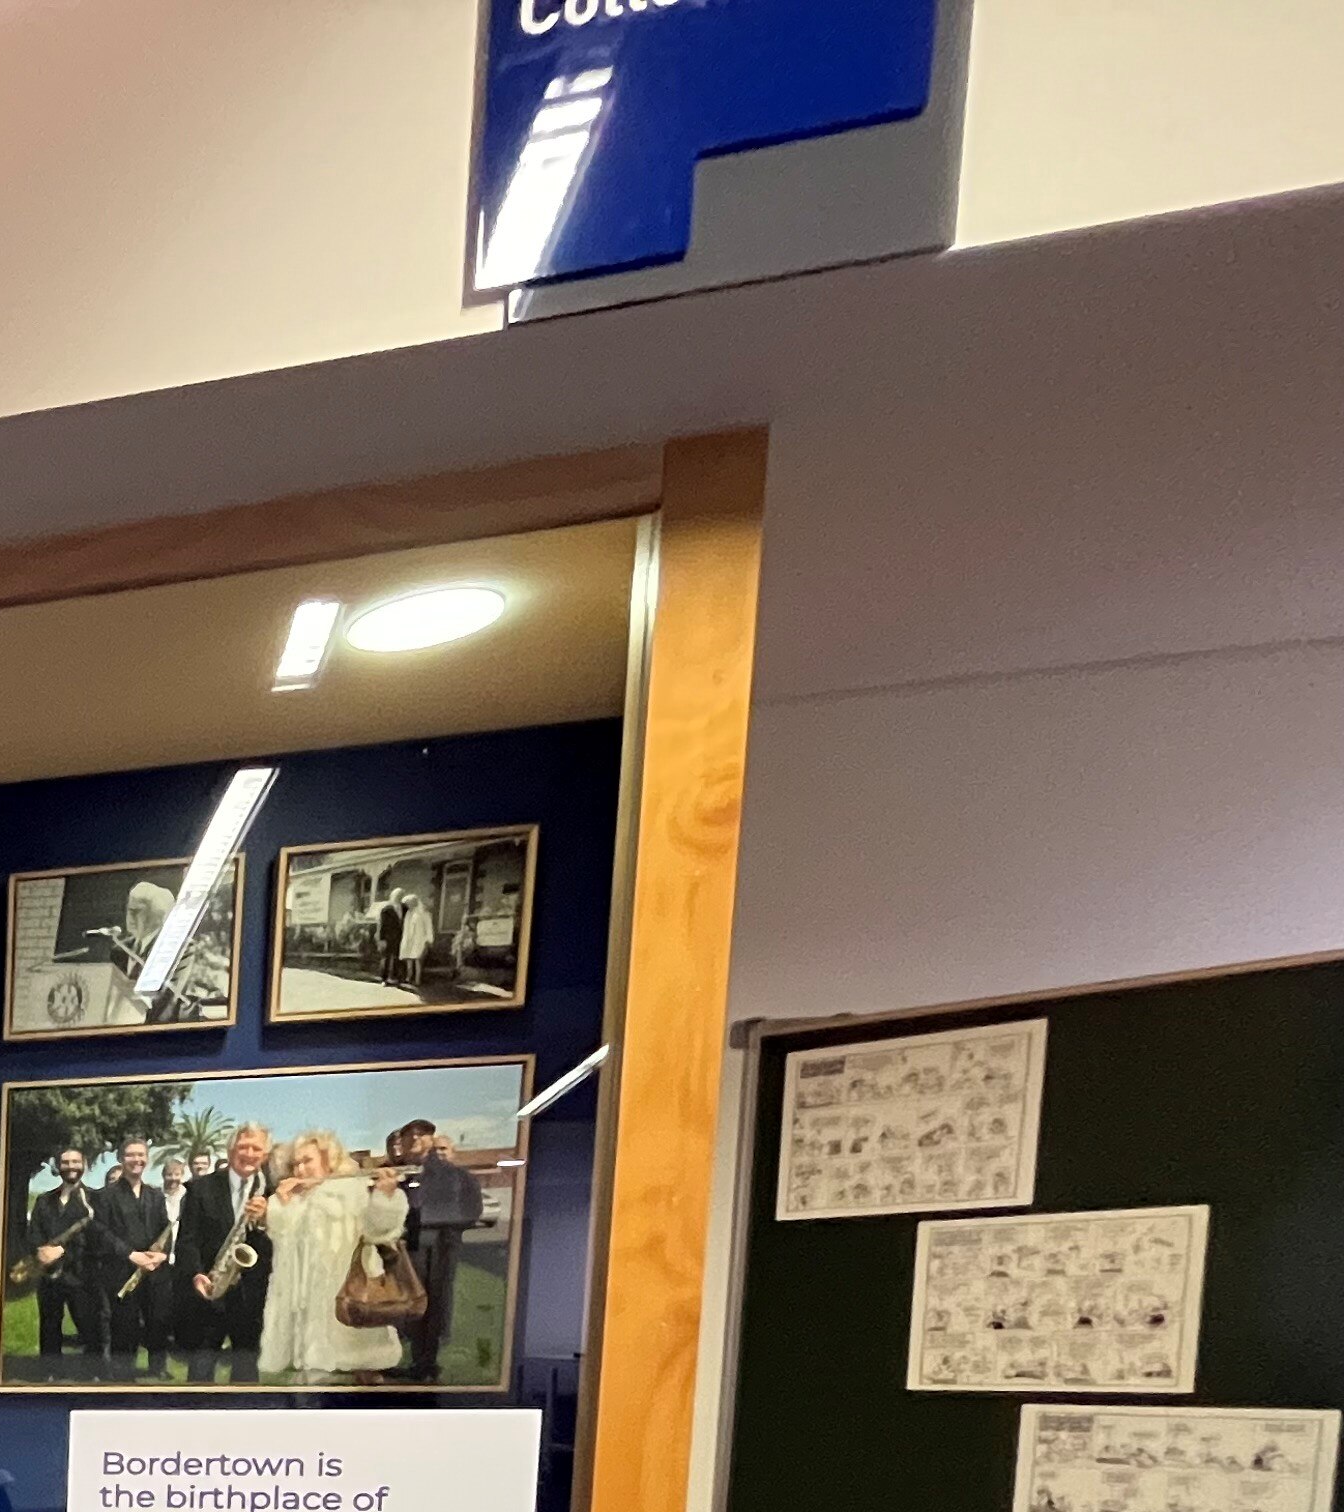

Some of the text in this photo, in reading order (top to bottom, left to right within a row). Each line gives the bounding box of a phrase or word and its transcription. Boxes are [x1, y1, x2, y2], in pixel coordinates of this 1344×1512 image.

[102, 1451, 343, 1477] Bordertown is
[99, 1484, 155, 1508] the
[352, 1486, 391, 1512] of
